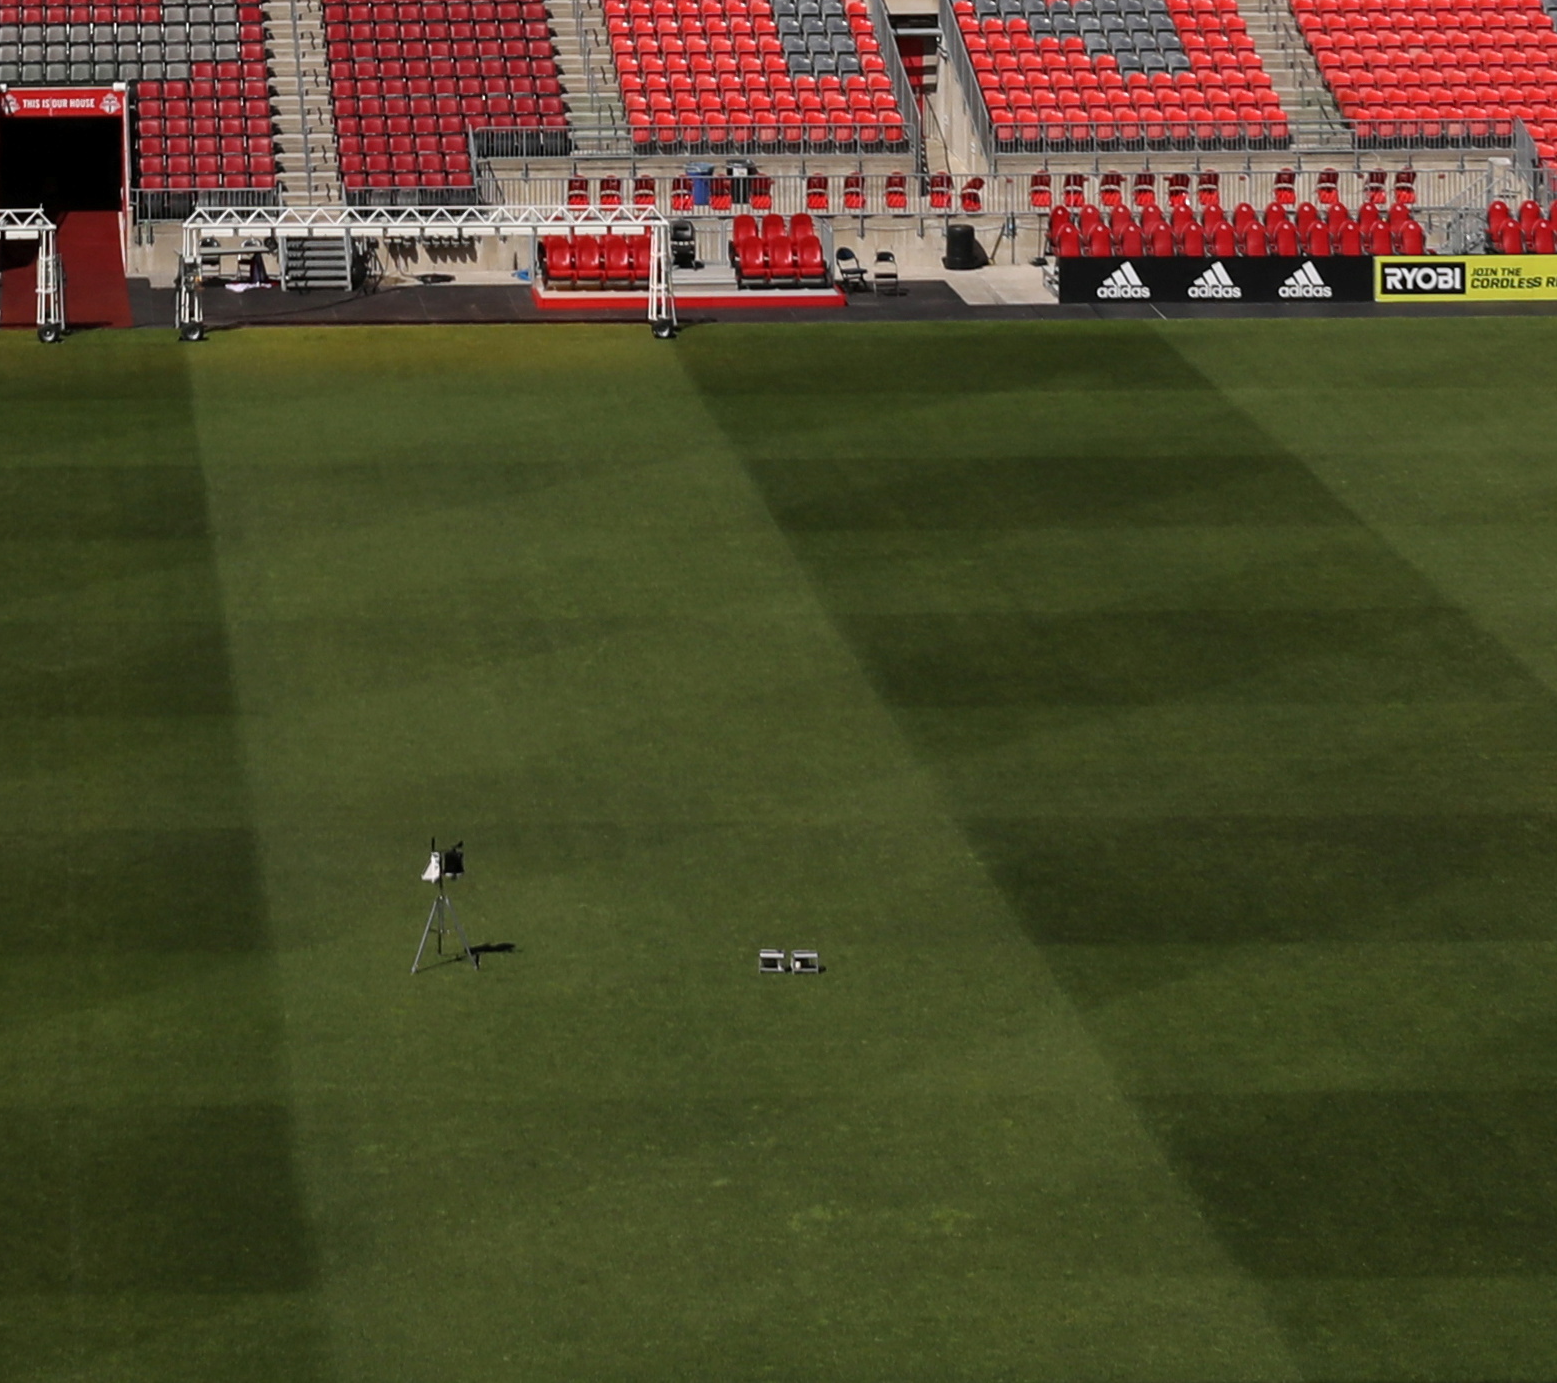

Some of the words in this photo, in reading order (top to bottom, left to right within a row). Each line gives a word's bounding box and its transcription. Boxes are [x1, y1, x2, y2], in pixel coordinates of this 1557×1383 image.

[23, 98, 40, 109] THIS
[42, 98, 50, 109] IS
[51, 98, 68, 109] OUR
[69, 97, 95, 109] HOUSE
[1385, 267, 1462, 290] RYOBI
[1471, 268, 1498, 277] JOIN
[1501, 267, 1522, 276] THE
[1471, 277, 1542, 289] CORDLESS
[1097, 285, 1151, 298] adidas
[1188, 284, 1242, 298] adidas
[1278, 284, 1333, 298] adidas
